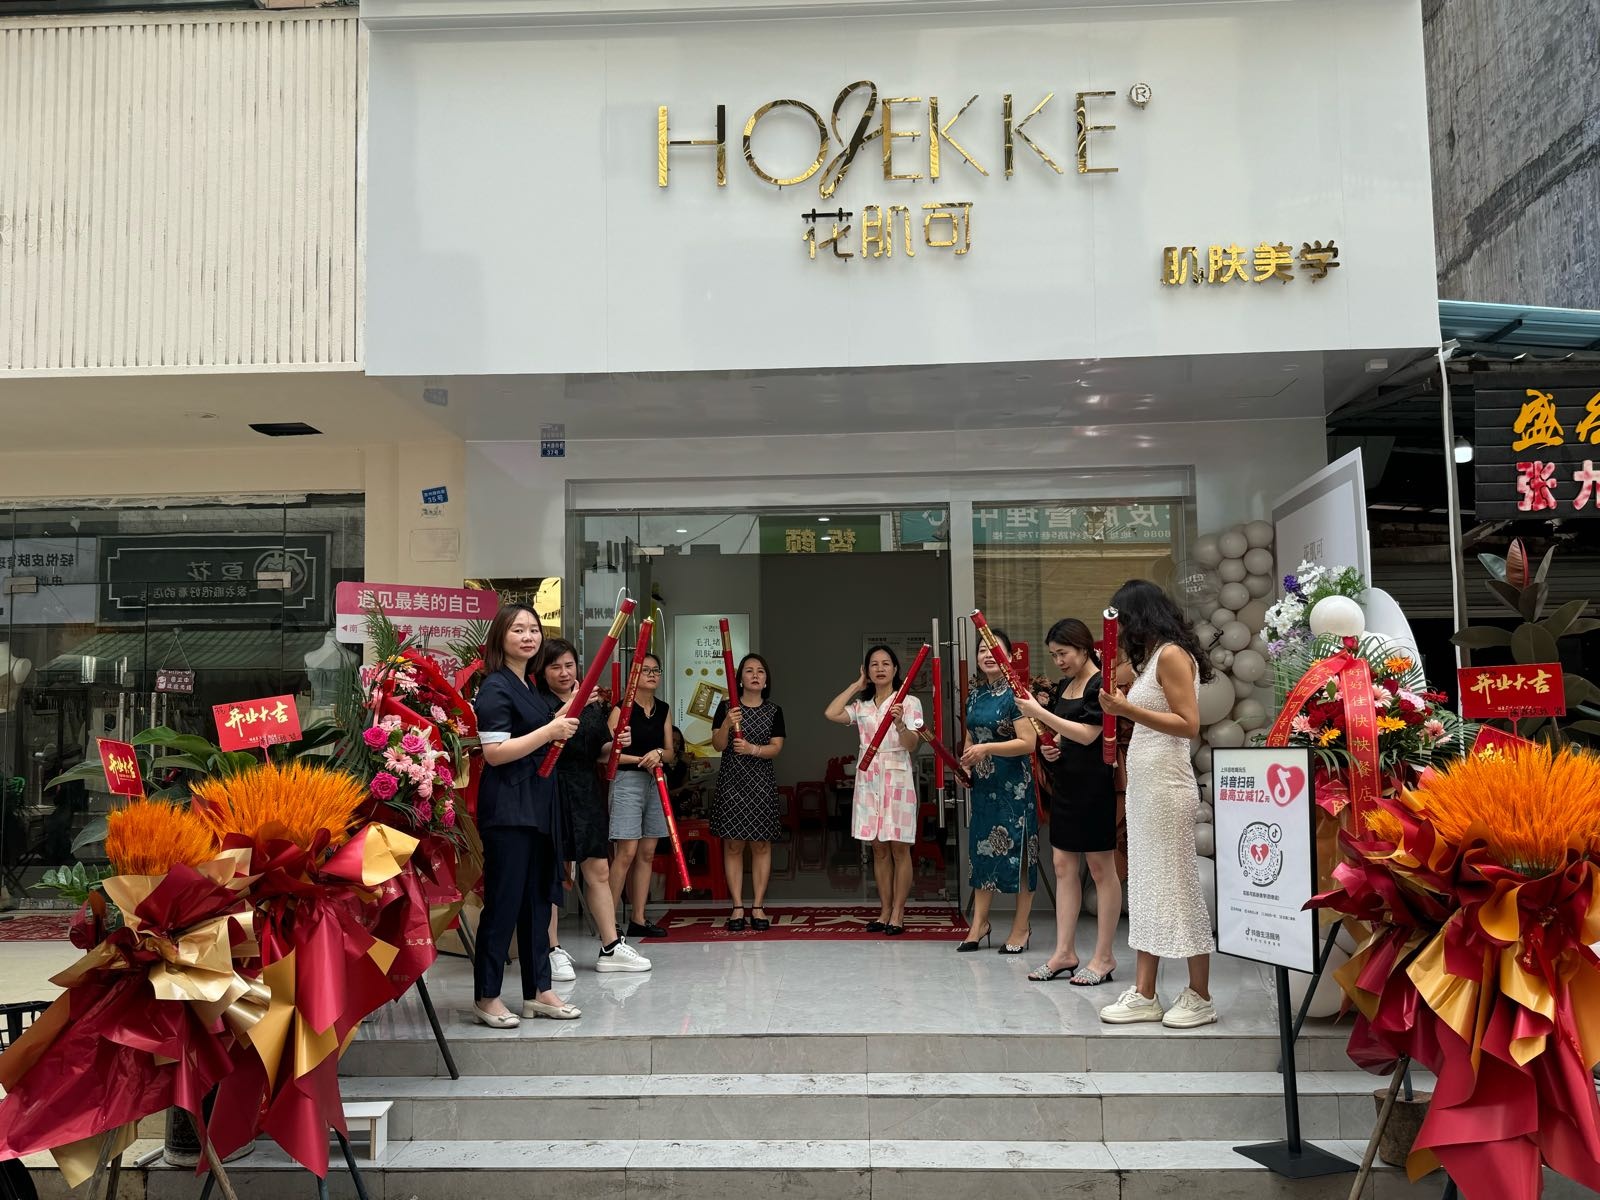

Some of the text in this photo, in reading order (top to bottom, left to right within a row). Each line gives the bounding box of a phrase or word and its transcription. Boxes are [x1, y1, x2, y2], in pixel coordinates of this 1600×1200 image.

[801, 202, 973, 259] 花肌可
[1161, 240, 1341, 287] 肌肤美学
[357, 589, 481, 613] 遇见最美的自己
[1470, 669, 1552, 705] 开业大吉
[225, 701, 288, 738] 开业大吉
[108, 753, 136, 785] 开业大吉
[1220, 775, 1255, 789] 抖音扫码
[1219, 788, 1270, 803] 最高立减12元
